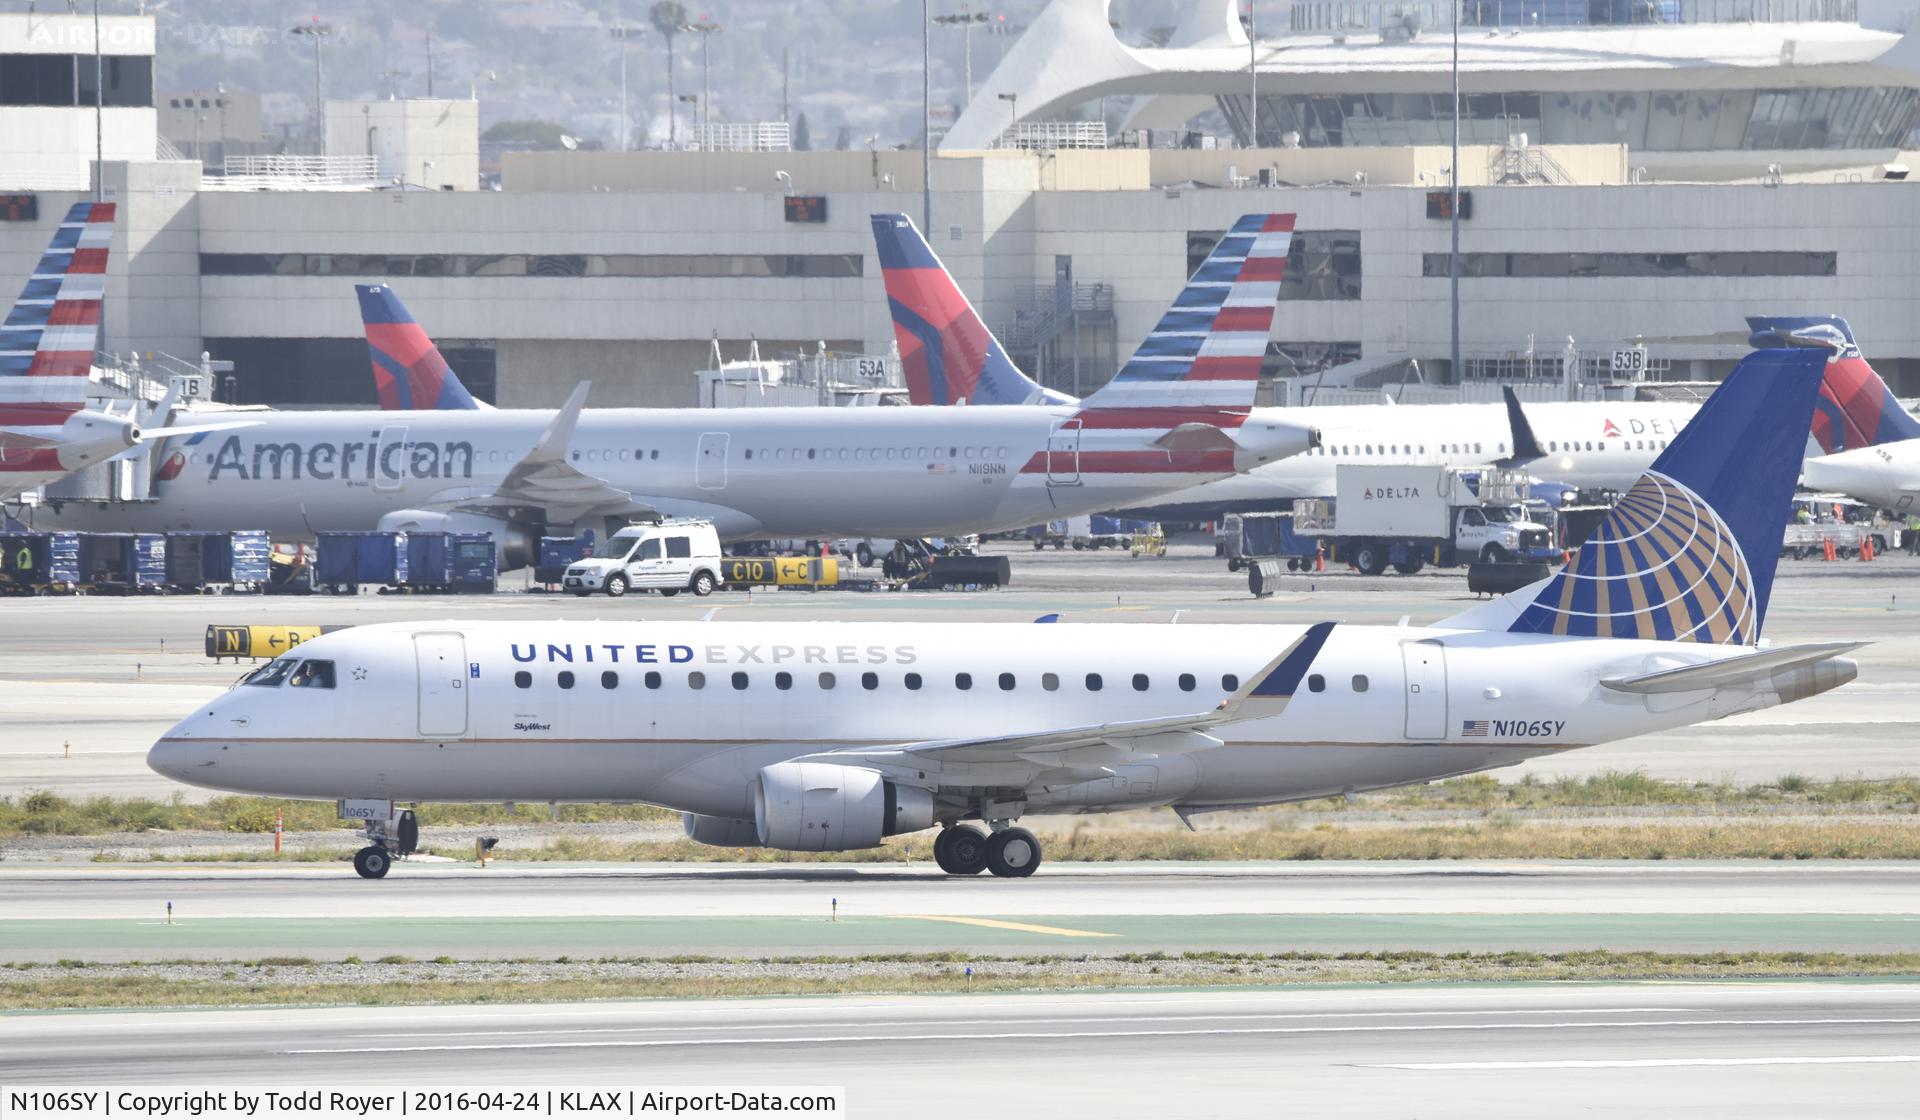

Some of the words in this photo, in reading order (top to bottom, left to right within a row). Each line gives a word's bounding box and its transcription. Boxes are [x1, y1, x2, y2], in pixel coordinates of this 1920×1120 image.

[1615, 351, 1641, 368] 53B
[860, 360, 884, 376] 53A
[209, 430, 473, 480] American
[969, 464, 1005, 474] N119NN
[1377, 487, 1420, 498] DELTA
[732, 563, 763, 580] C10
[798, 563, 808, 580] C
[226, 630, 240, 652] N
[513, 722, 551, 732] SkyWest
[1494, 720, 1565, 736] N106SY
[346, 807, 376, 818] 106SY
